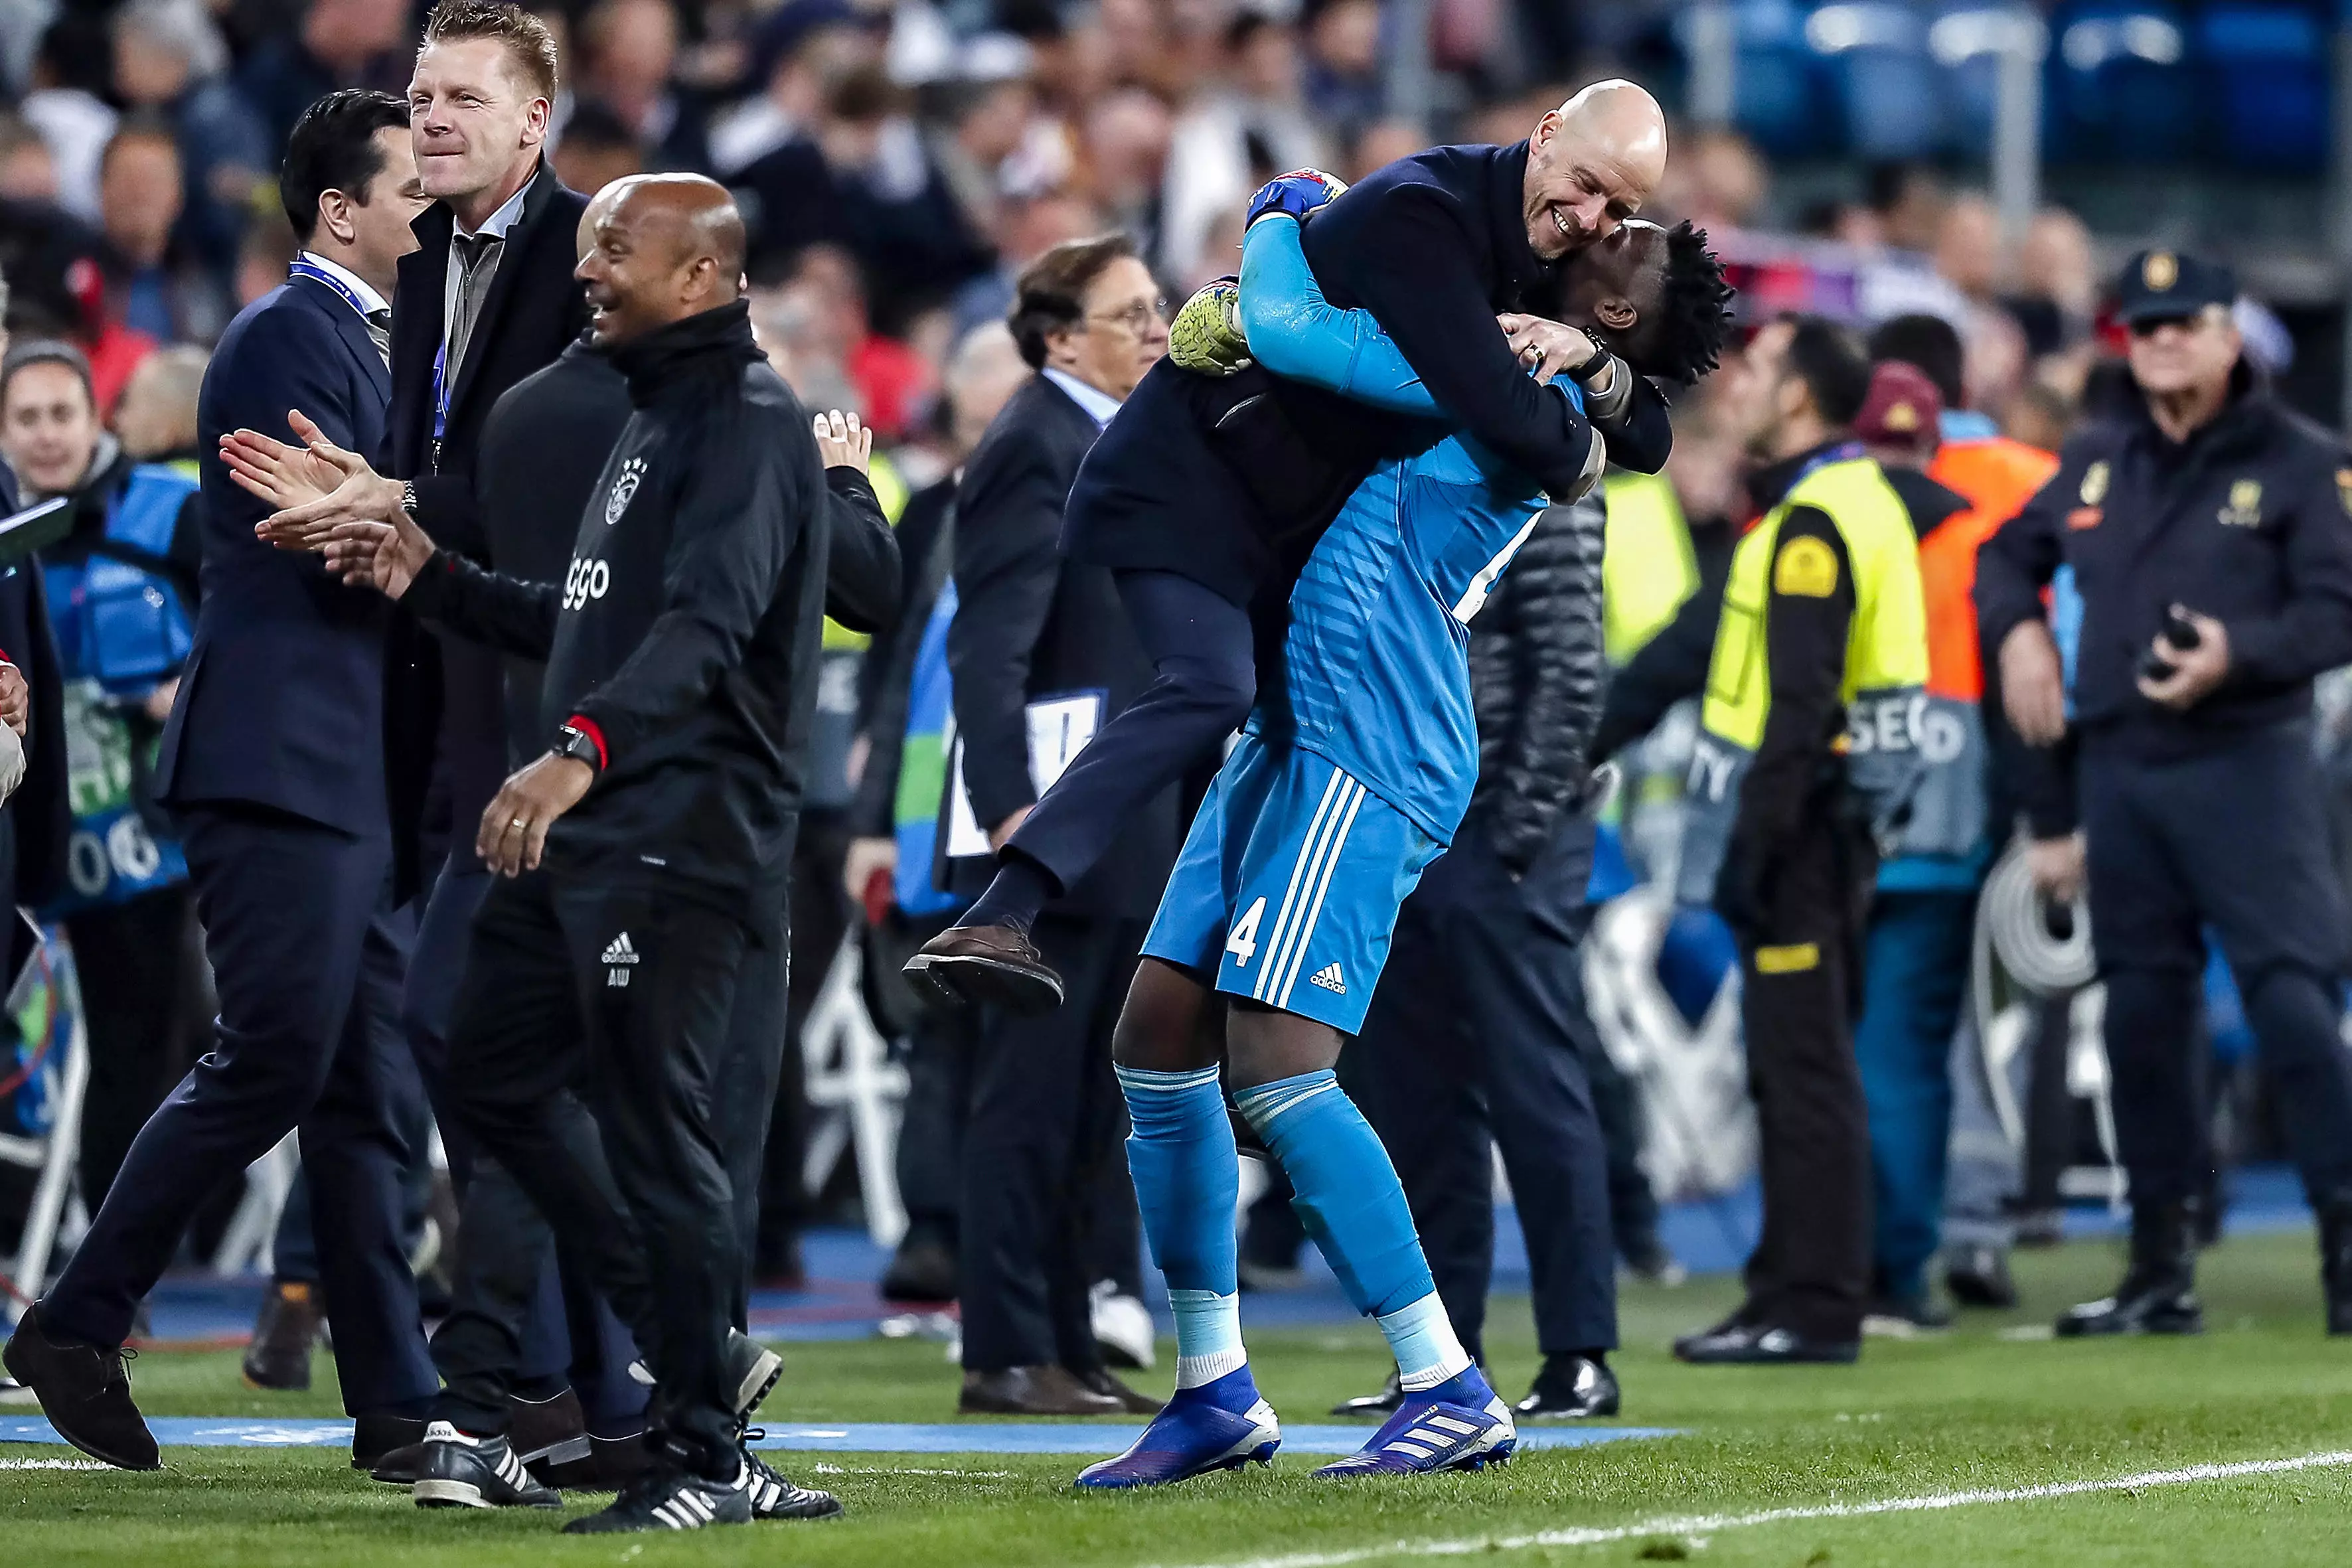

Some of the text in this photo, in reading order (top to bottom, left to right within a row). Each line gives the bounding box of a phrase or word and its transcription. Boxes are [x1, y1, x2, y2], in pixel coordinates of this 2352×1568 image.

[562, 552, 610, 611] ggo
[1226, 896, 1267, 967] 4
[1310, 975, 1347, 995] adidas
